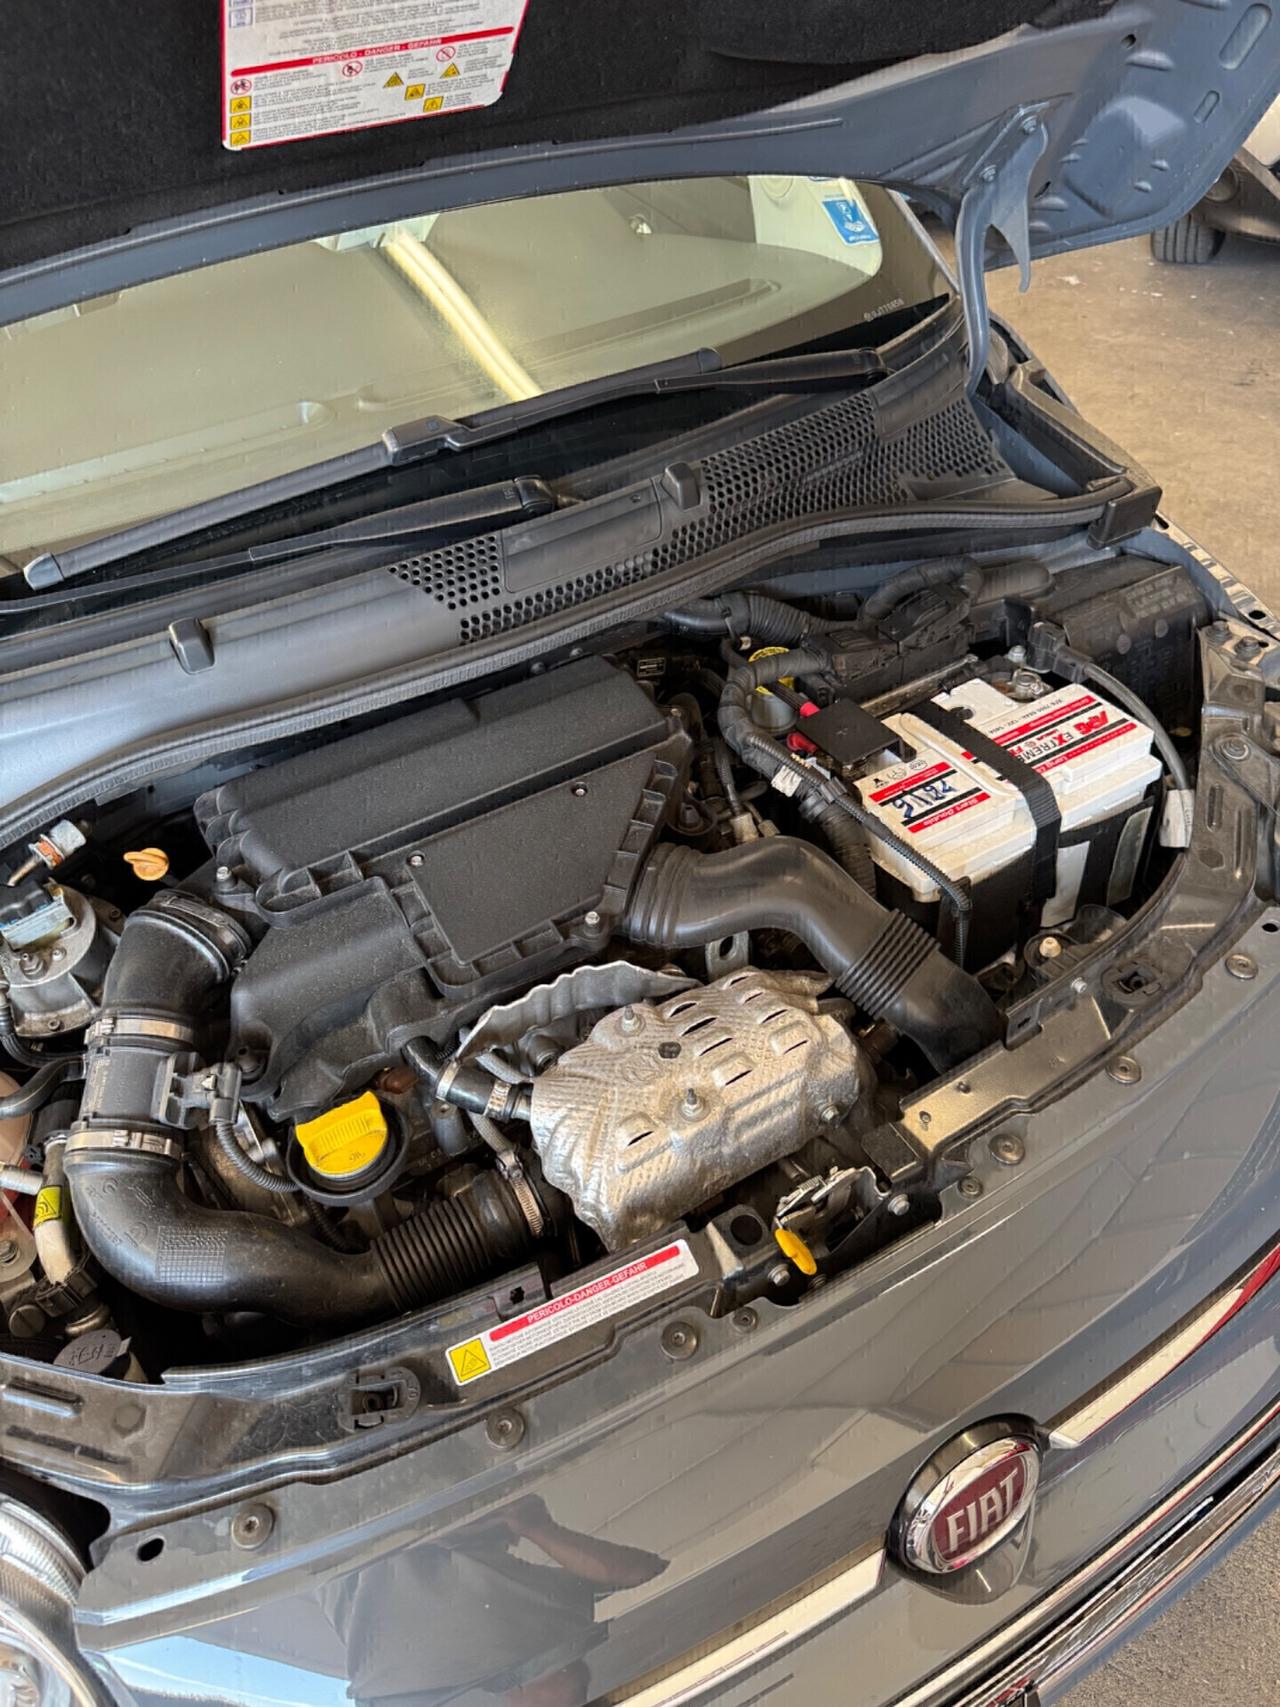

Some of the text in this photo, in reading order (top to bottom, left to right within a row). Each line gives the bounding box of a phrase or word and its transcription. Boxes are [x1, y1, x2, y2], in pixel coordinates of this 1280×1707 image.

[312, 52, 358, 64] PERICOLO
[364, 45, 401, 56] DANGER
[407, 38, 442, 49] GEFAHR
[945, 1465, 1019, 1553] FIAT
